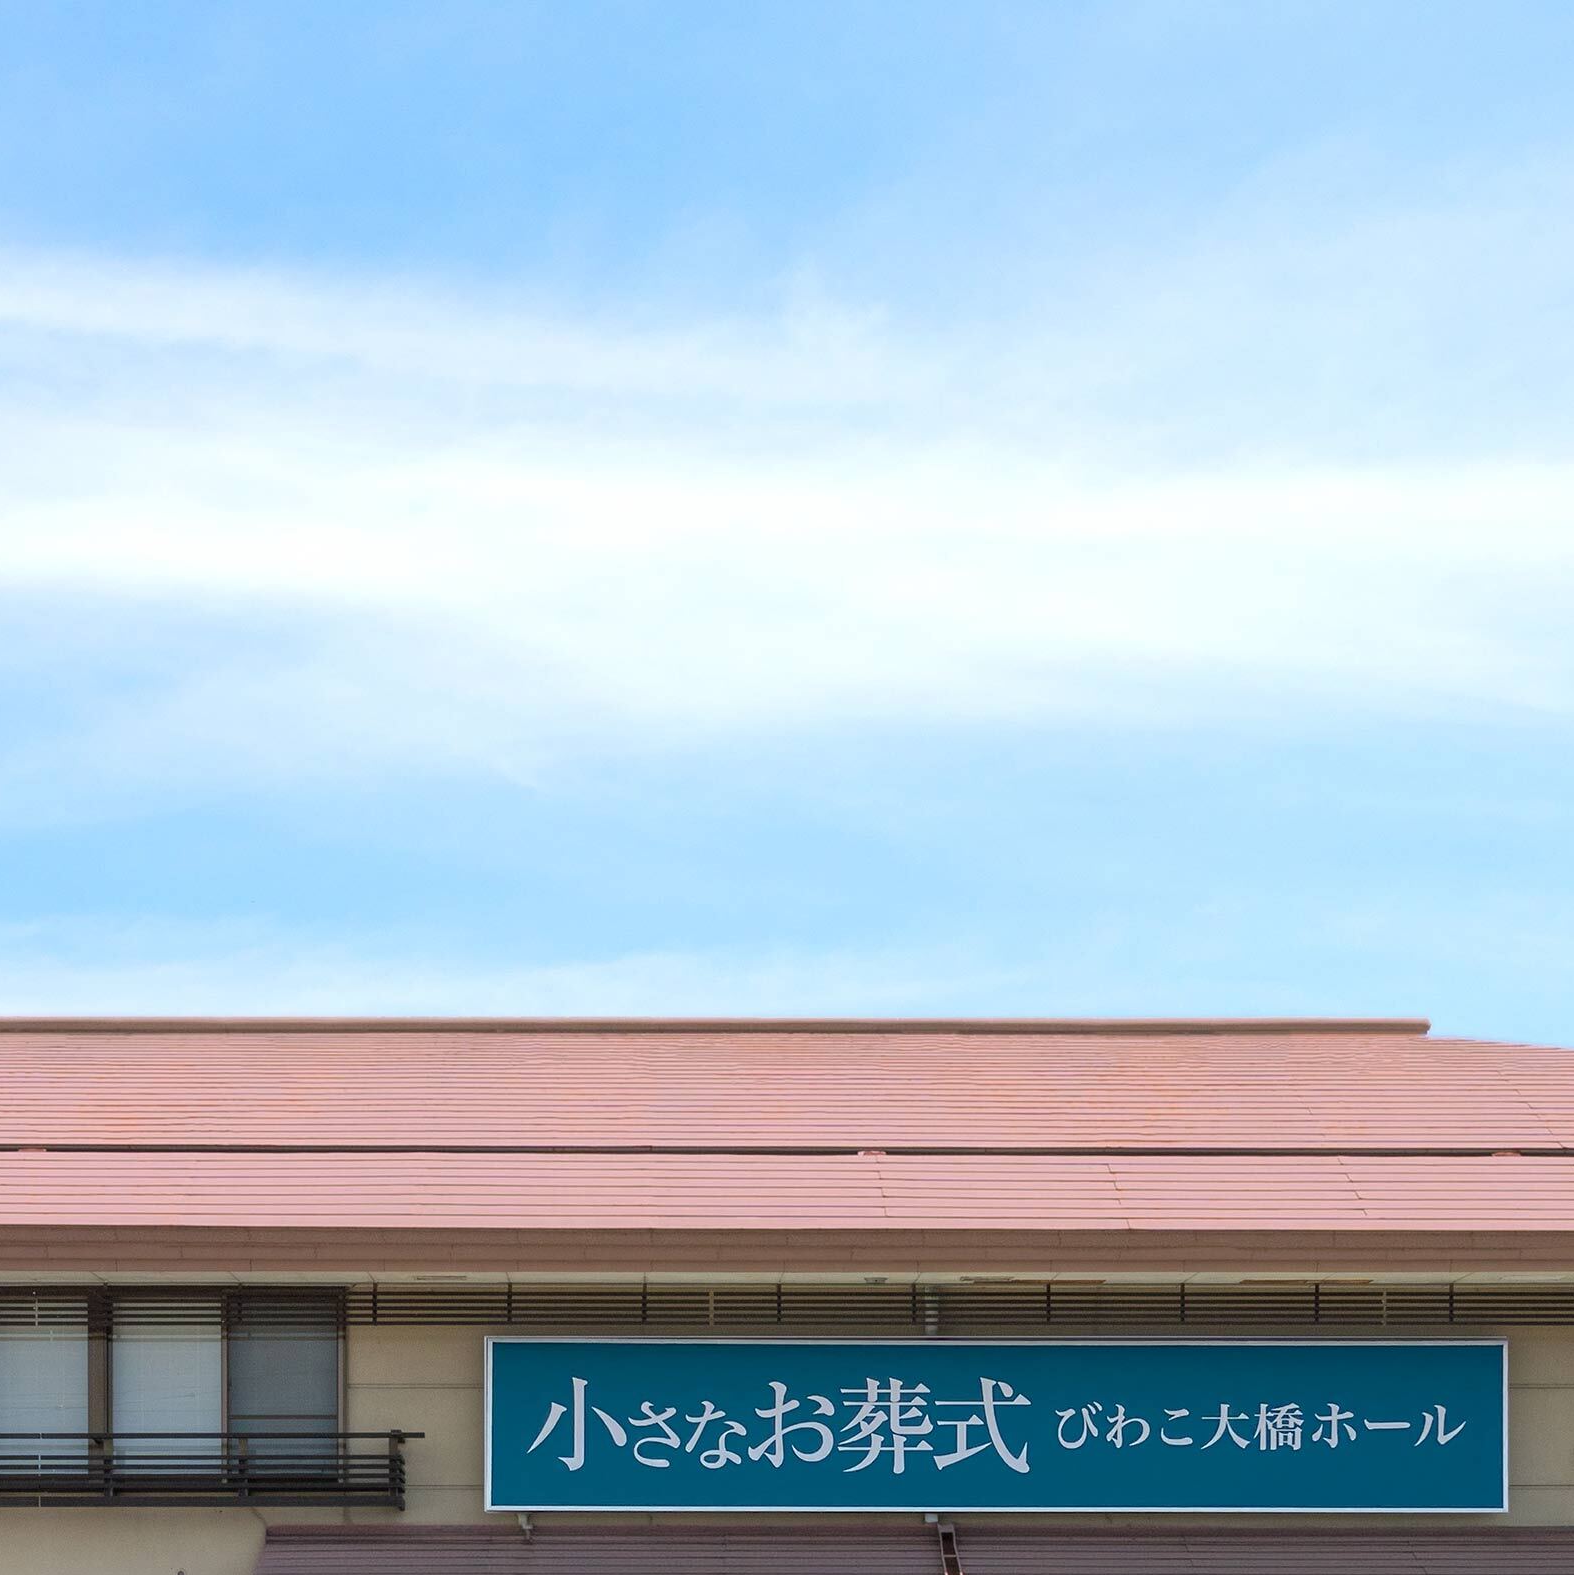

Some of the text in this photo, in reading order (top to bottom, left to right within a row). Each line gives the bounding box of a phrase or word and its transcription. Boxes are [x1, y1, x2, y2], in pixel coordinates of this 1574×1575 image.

[527, 1376, 1466, 1474] 小さなお葬式 びわこ大橋ホール
